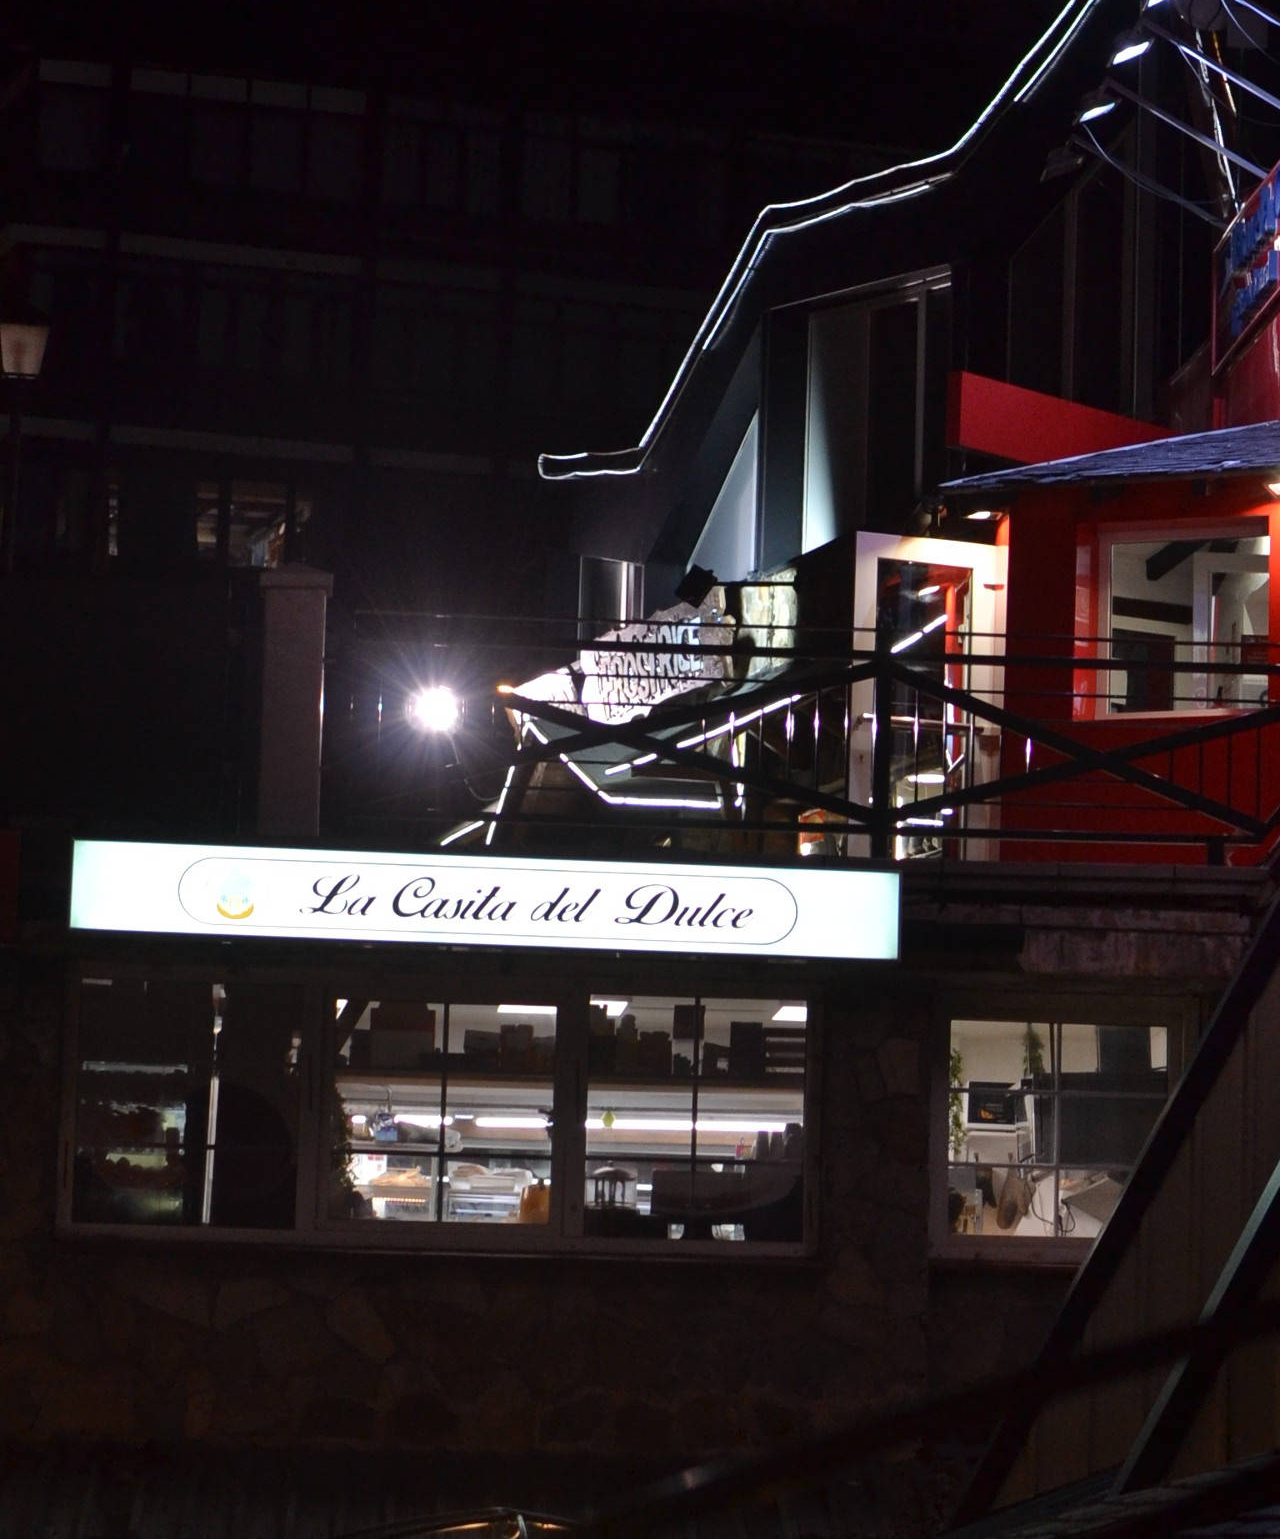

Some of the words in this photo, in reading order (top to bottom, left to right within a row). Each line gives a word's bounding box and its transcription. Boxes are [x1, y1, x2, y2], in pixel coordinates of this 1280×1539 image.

[300, 874, 374, 916] La
[391, 876, 517, 924] Casita
[530, 887, 601, 924] del
[615, 884, 755, 929] Dulce
